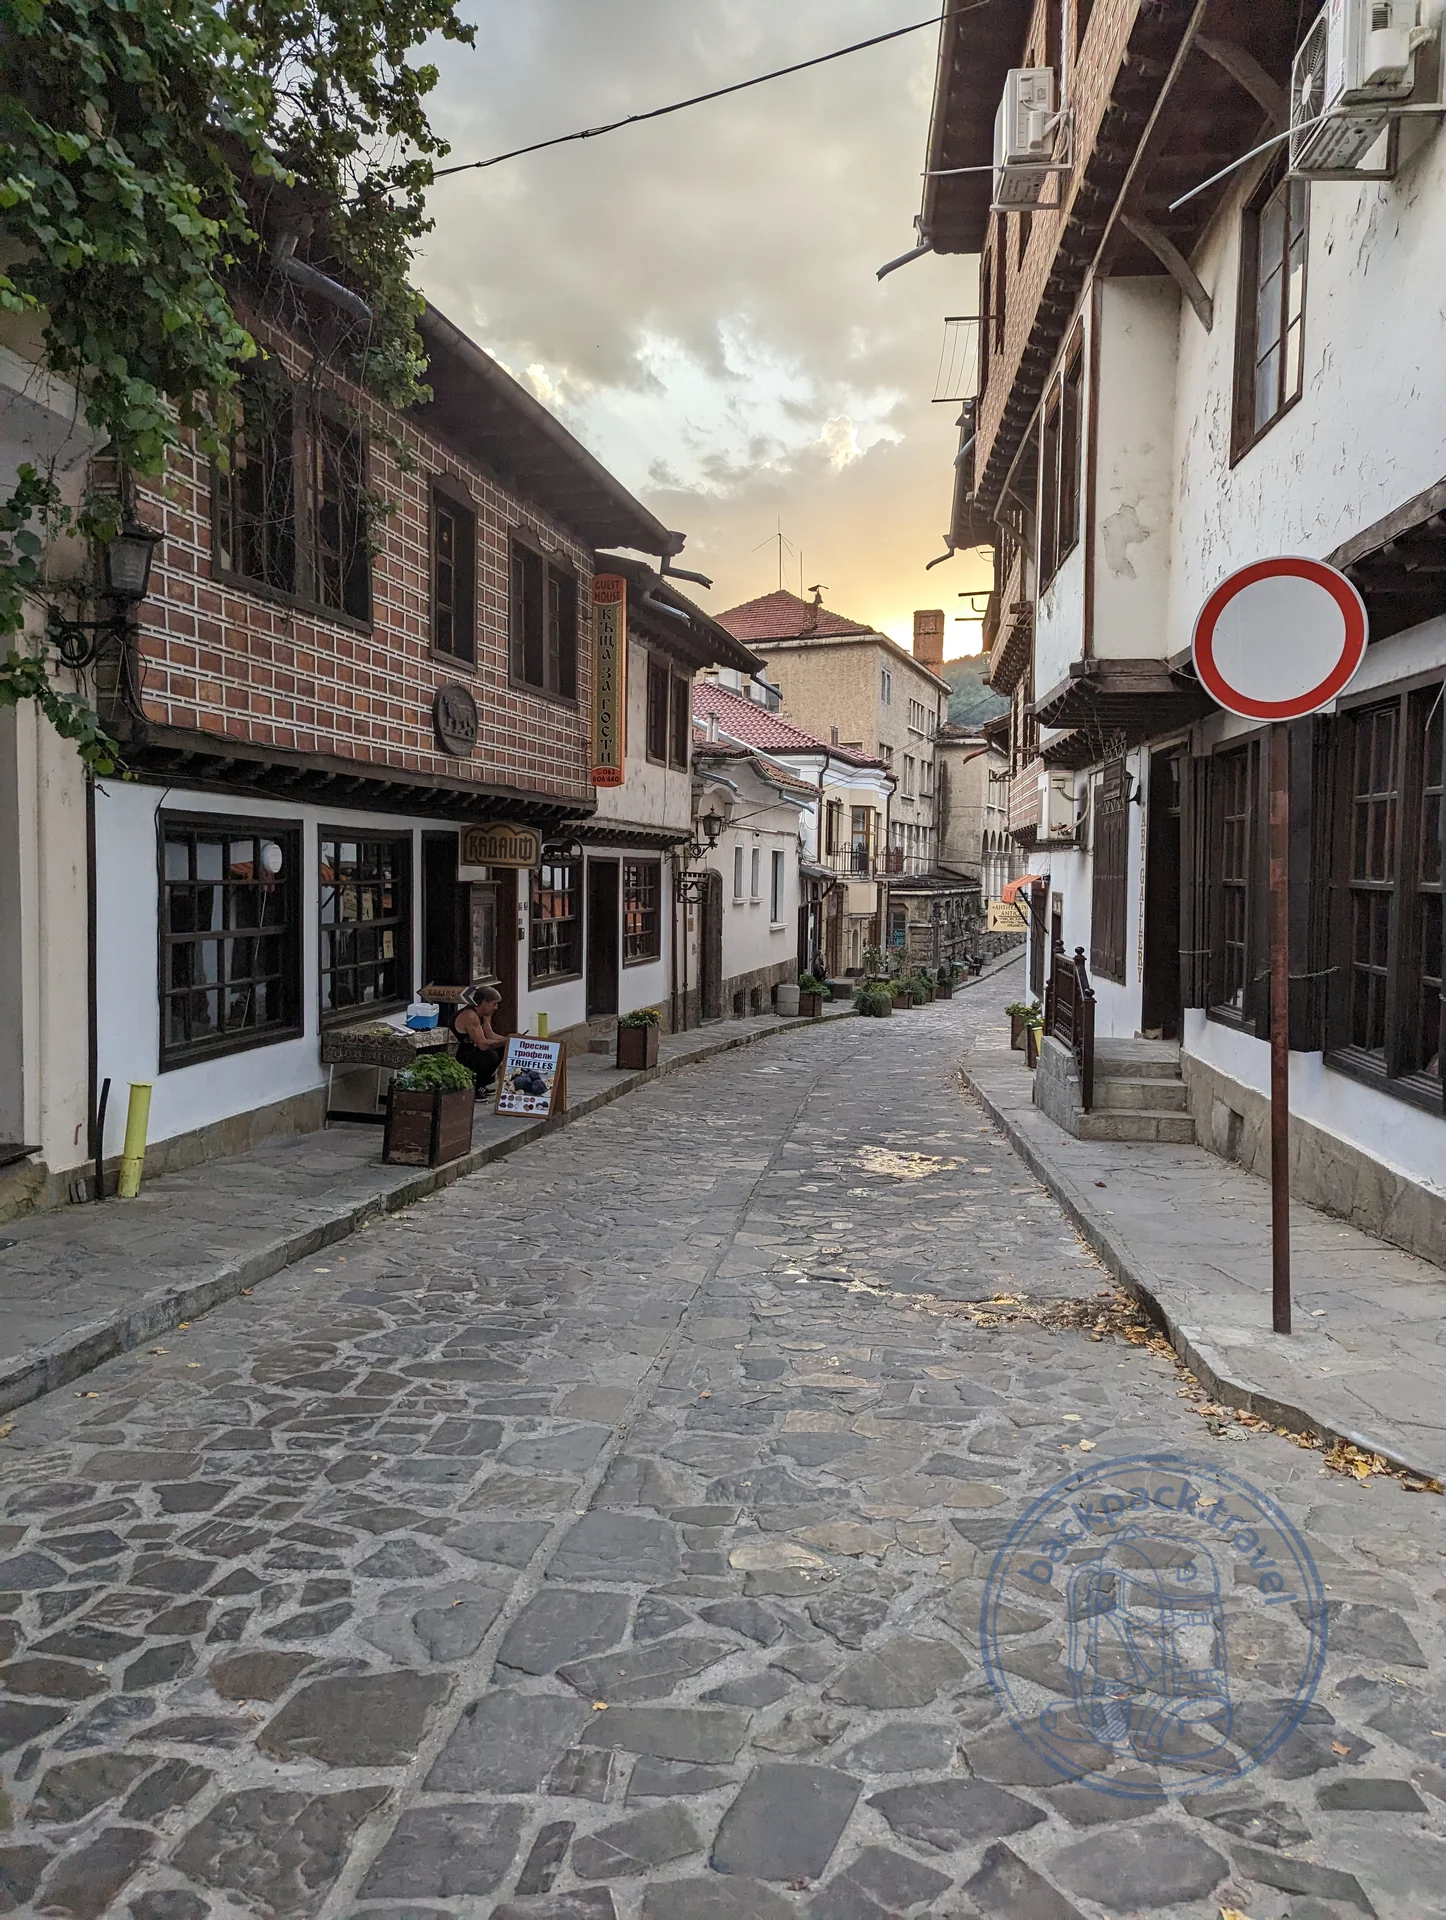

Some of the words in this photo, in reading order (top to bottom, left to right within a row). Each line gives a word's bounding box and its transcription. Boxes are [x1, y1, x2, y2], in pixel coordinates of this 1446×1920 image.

[595, 581, 620, 590] GUEST
[594, 591, 620, 602] HOUSE
[600, 608, 615, 660] КЪЩА
[600, 666, 612, 692] ЗА
[600, 698, 613, 763] ГОСТИ
[469, 835, 533, 861] КАДАИФ
[1138, 867, 1146, 983] GALLERY
[513, 1050, 553, 1060] трюфели
[519, 1040, 550, 1051] Пресни
[510, 1058, 554, 1070] TRUFFLES
